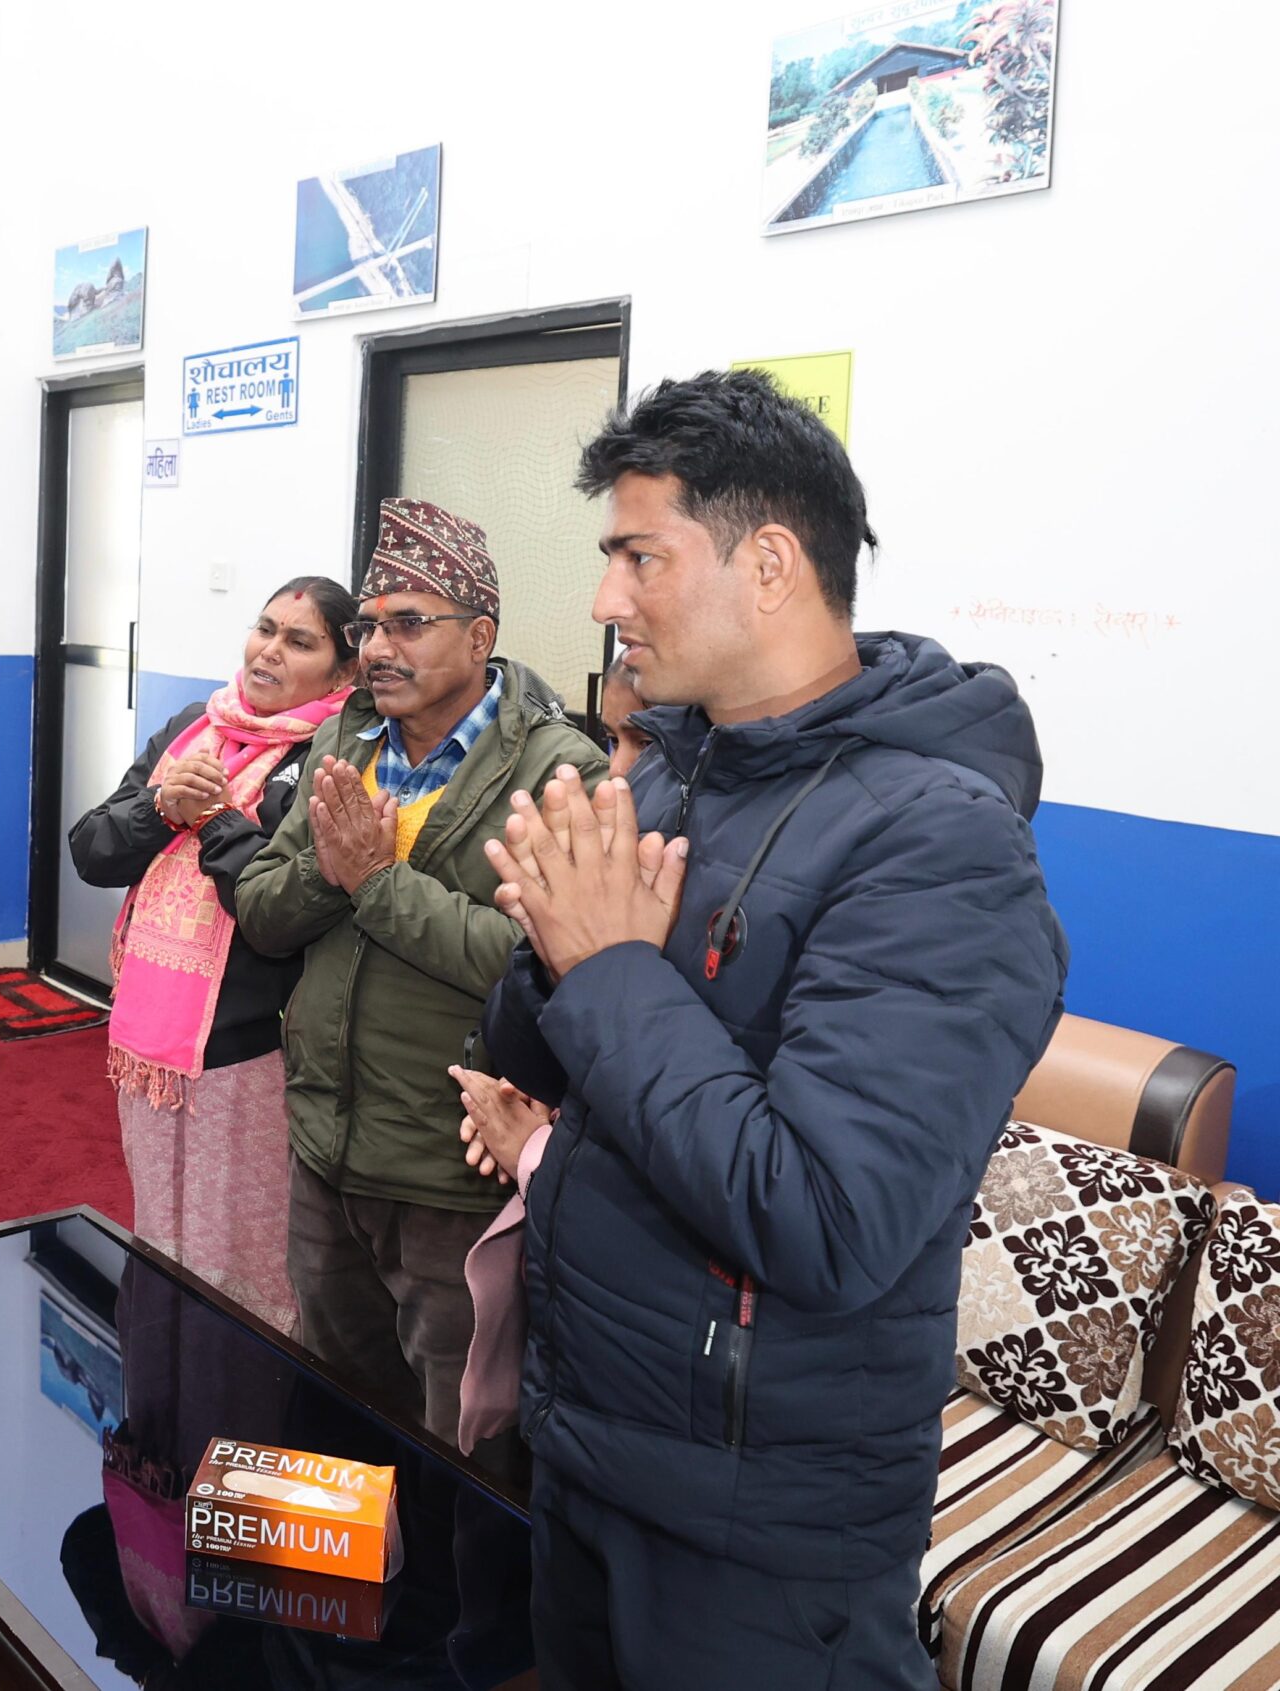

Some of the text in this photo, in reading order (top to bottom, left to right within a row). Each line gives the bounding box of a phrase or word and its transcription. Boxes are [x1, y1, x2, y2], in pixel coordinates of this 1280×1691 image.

[189, 351, 292, 385] शौचालय
[206, 379, 276, 405] REST ROOM
[186, 419, 212, 430] Ladies
[265, 409, 294, 421] Gents
[146, 446, 178, 479] महिला
[210, 1444, 365, 1491] PREMIUM
[225, 1461, 255, 1471] PREMIUM
[191, 1507, 350, 1558] PREMIUM
[206, 1535, 233, 1545] PREMIUM
